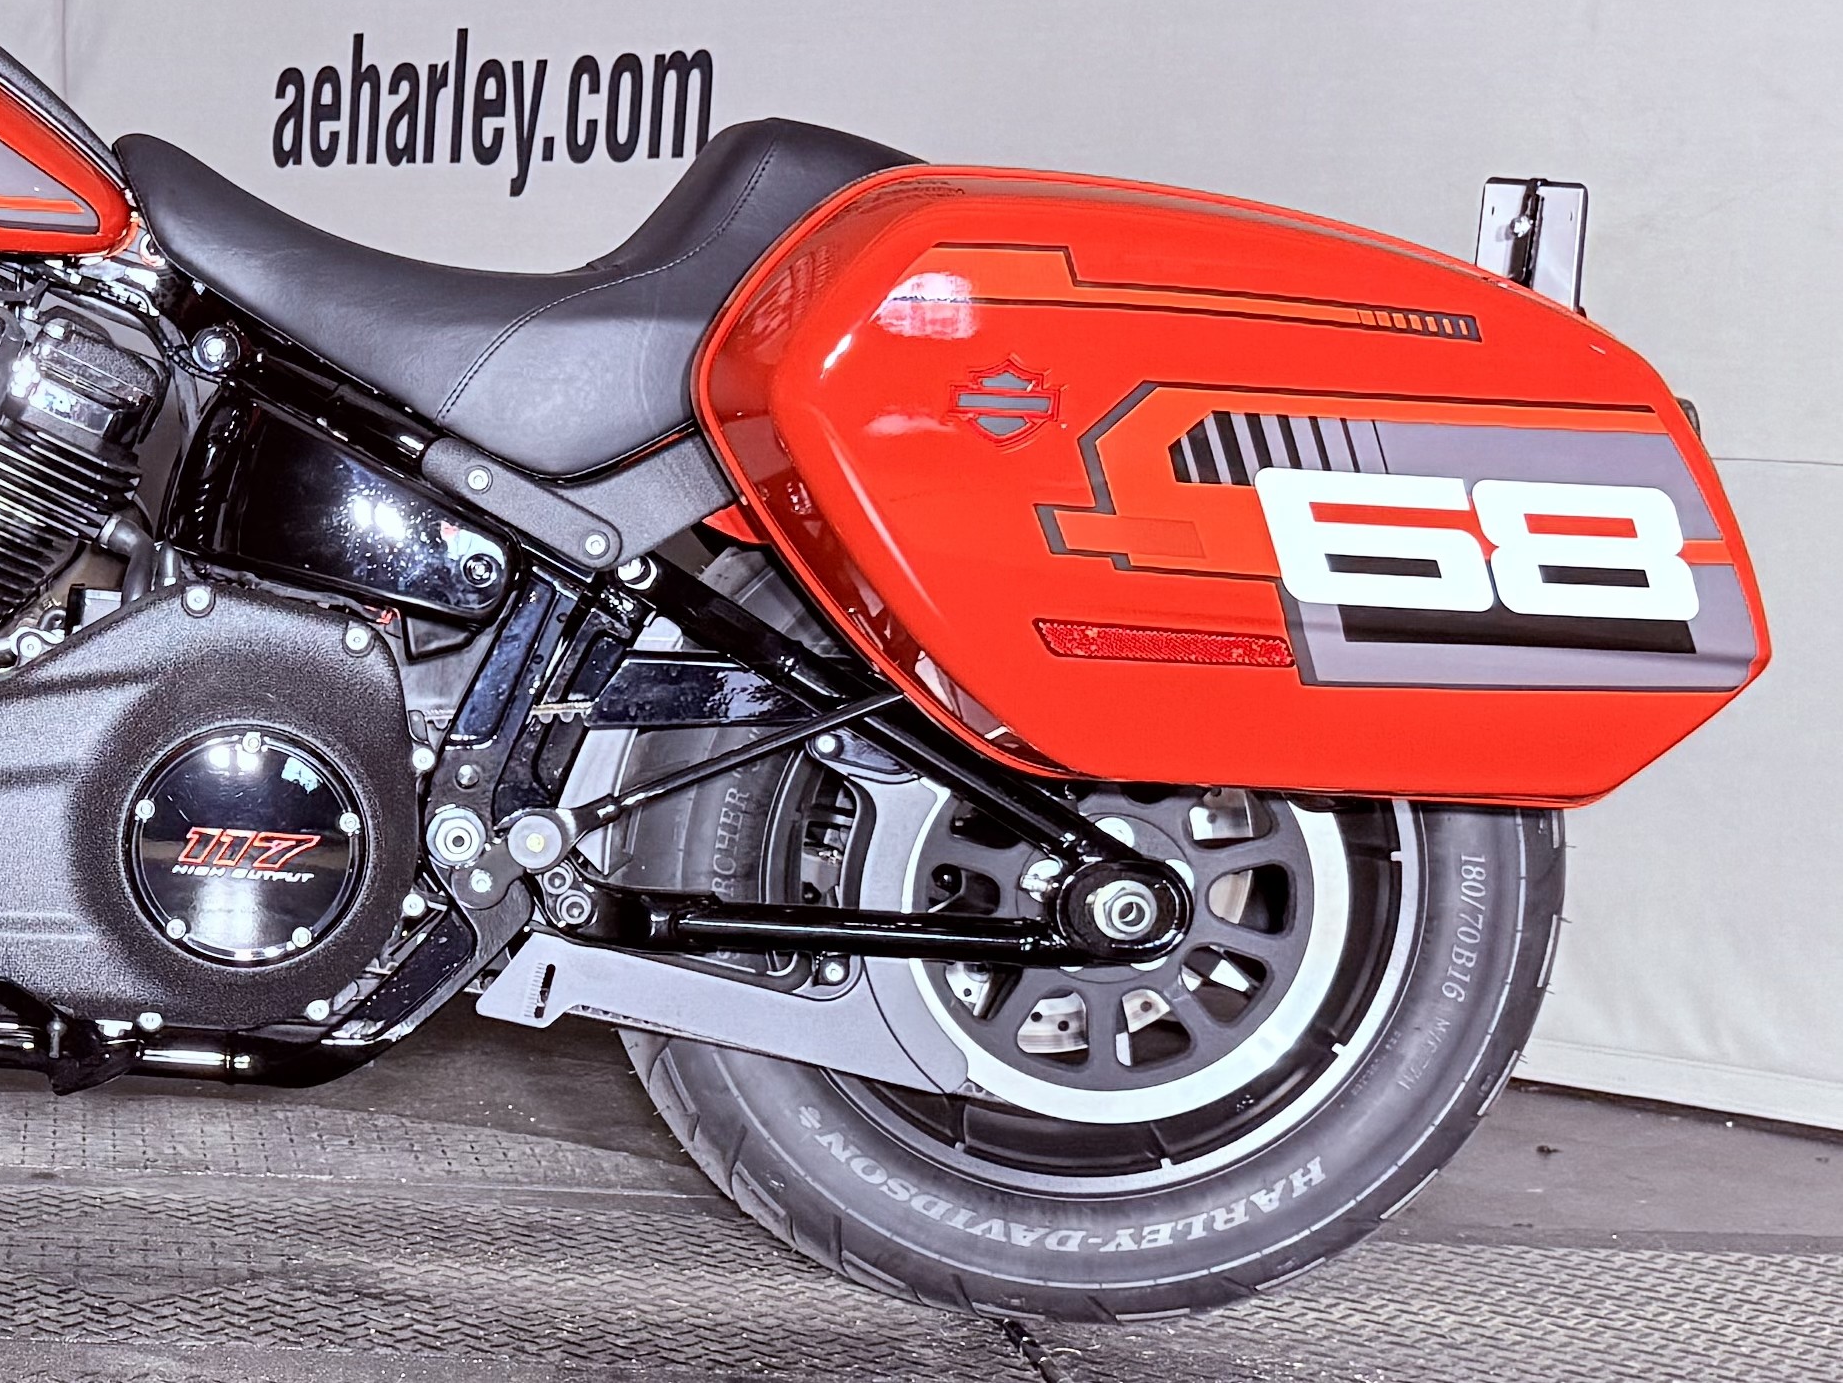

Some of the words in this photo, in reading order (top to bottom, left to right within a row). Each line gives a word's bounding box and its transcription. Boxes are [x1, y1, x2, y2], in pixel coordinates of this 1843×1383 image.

[273, 28, 714, 197] aeharley.com
[1255, 467, 1700, 621] 68
[177, 826, 321, 870] 117
[231, 868, 315, 883] OUTPUT
[815, 1126, 1327, 1253] HARLEY-DAVIDSON
